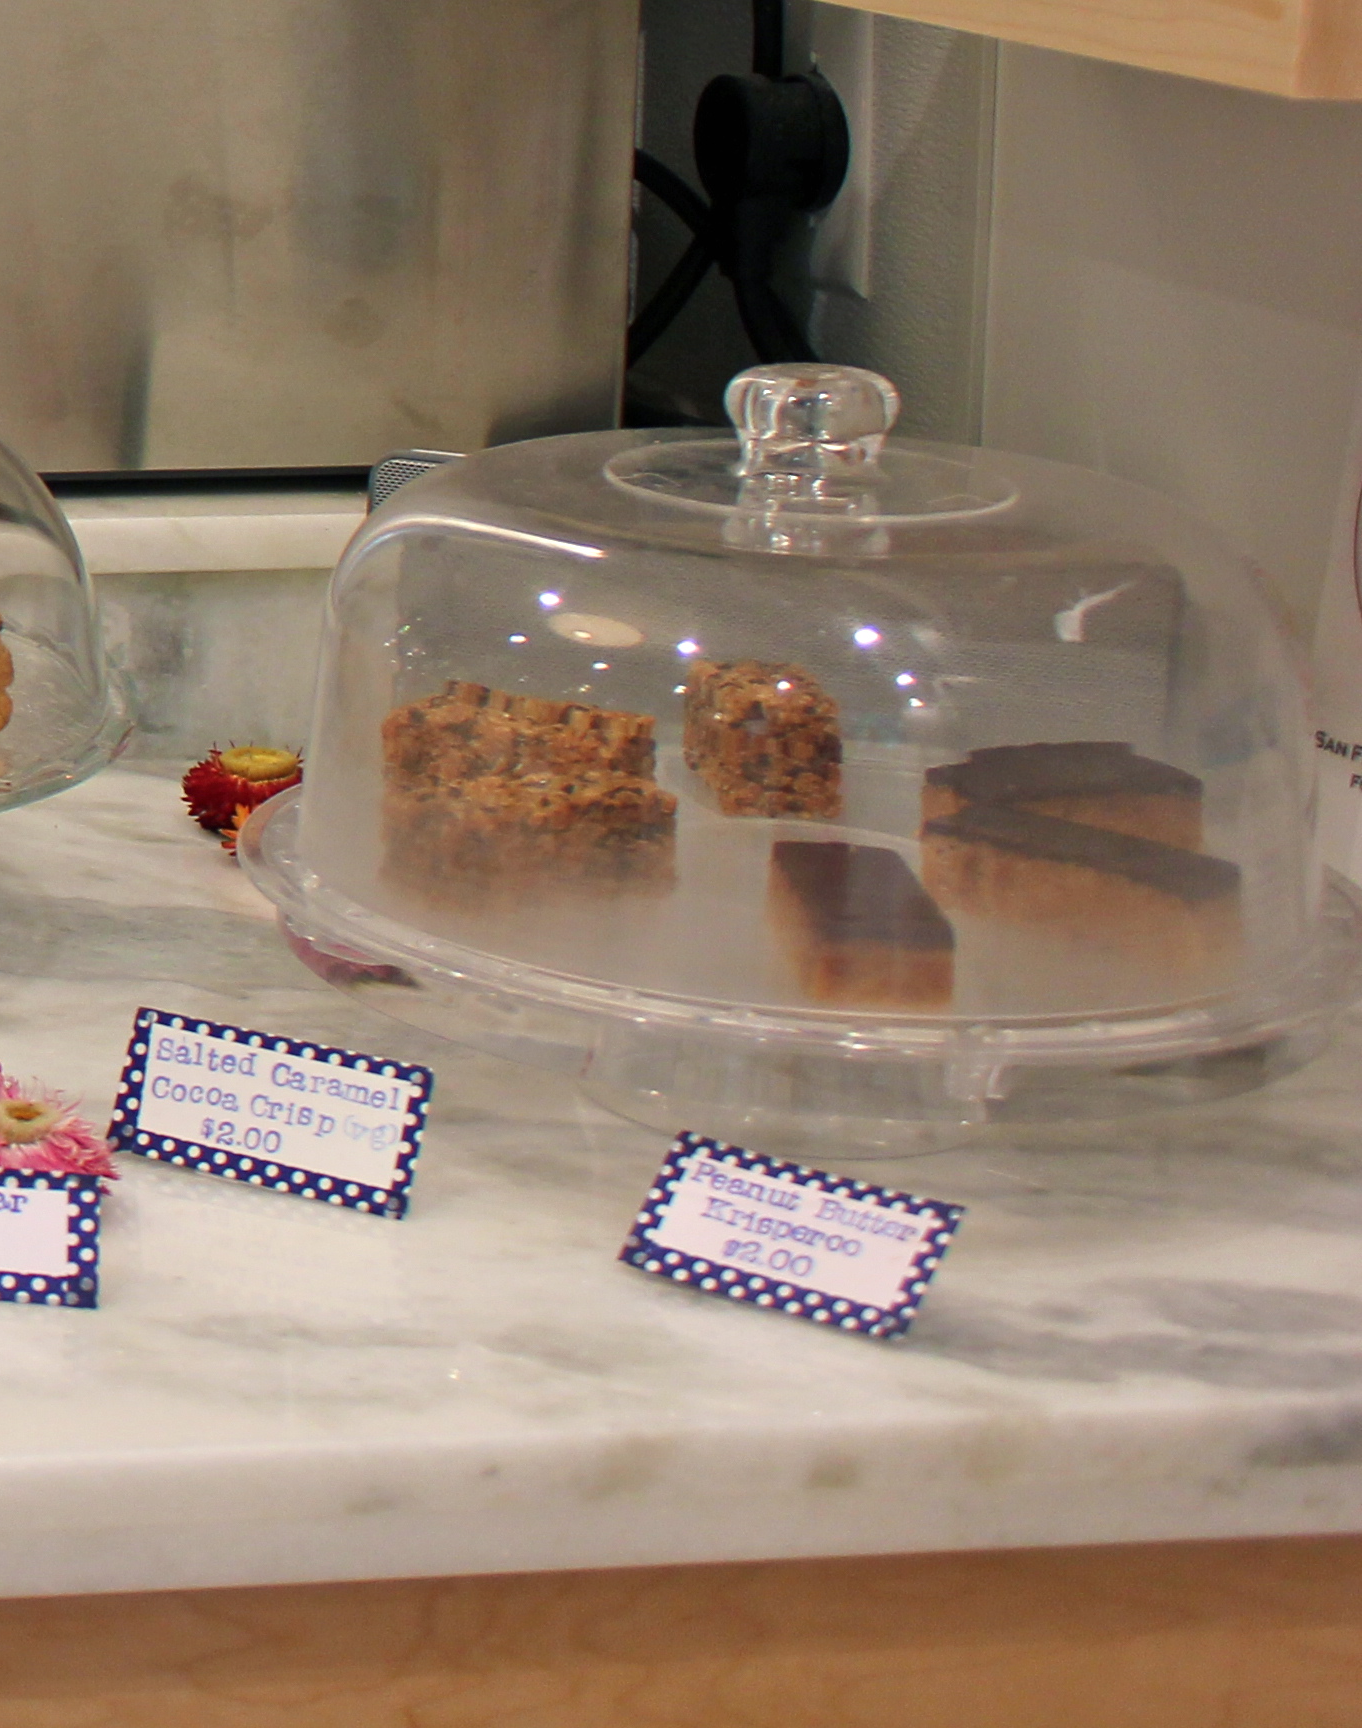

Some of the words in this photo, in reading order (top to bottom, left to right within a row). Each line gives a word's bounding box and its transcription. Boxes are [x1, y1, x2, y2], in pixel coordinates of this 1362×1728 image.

[156, 1037, 258, 1077] Salted
[271, 1062, 401, 1111] Caramel
[151, 1076, 239, 1113] Cocoa
[250, 1093, 335, 1138] Crisp
[200, 1117, 282, 1155] $2.00
[691, 1162, 801, 1211] Peanut
[723, 1239, 814, 1277] $2.00
